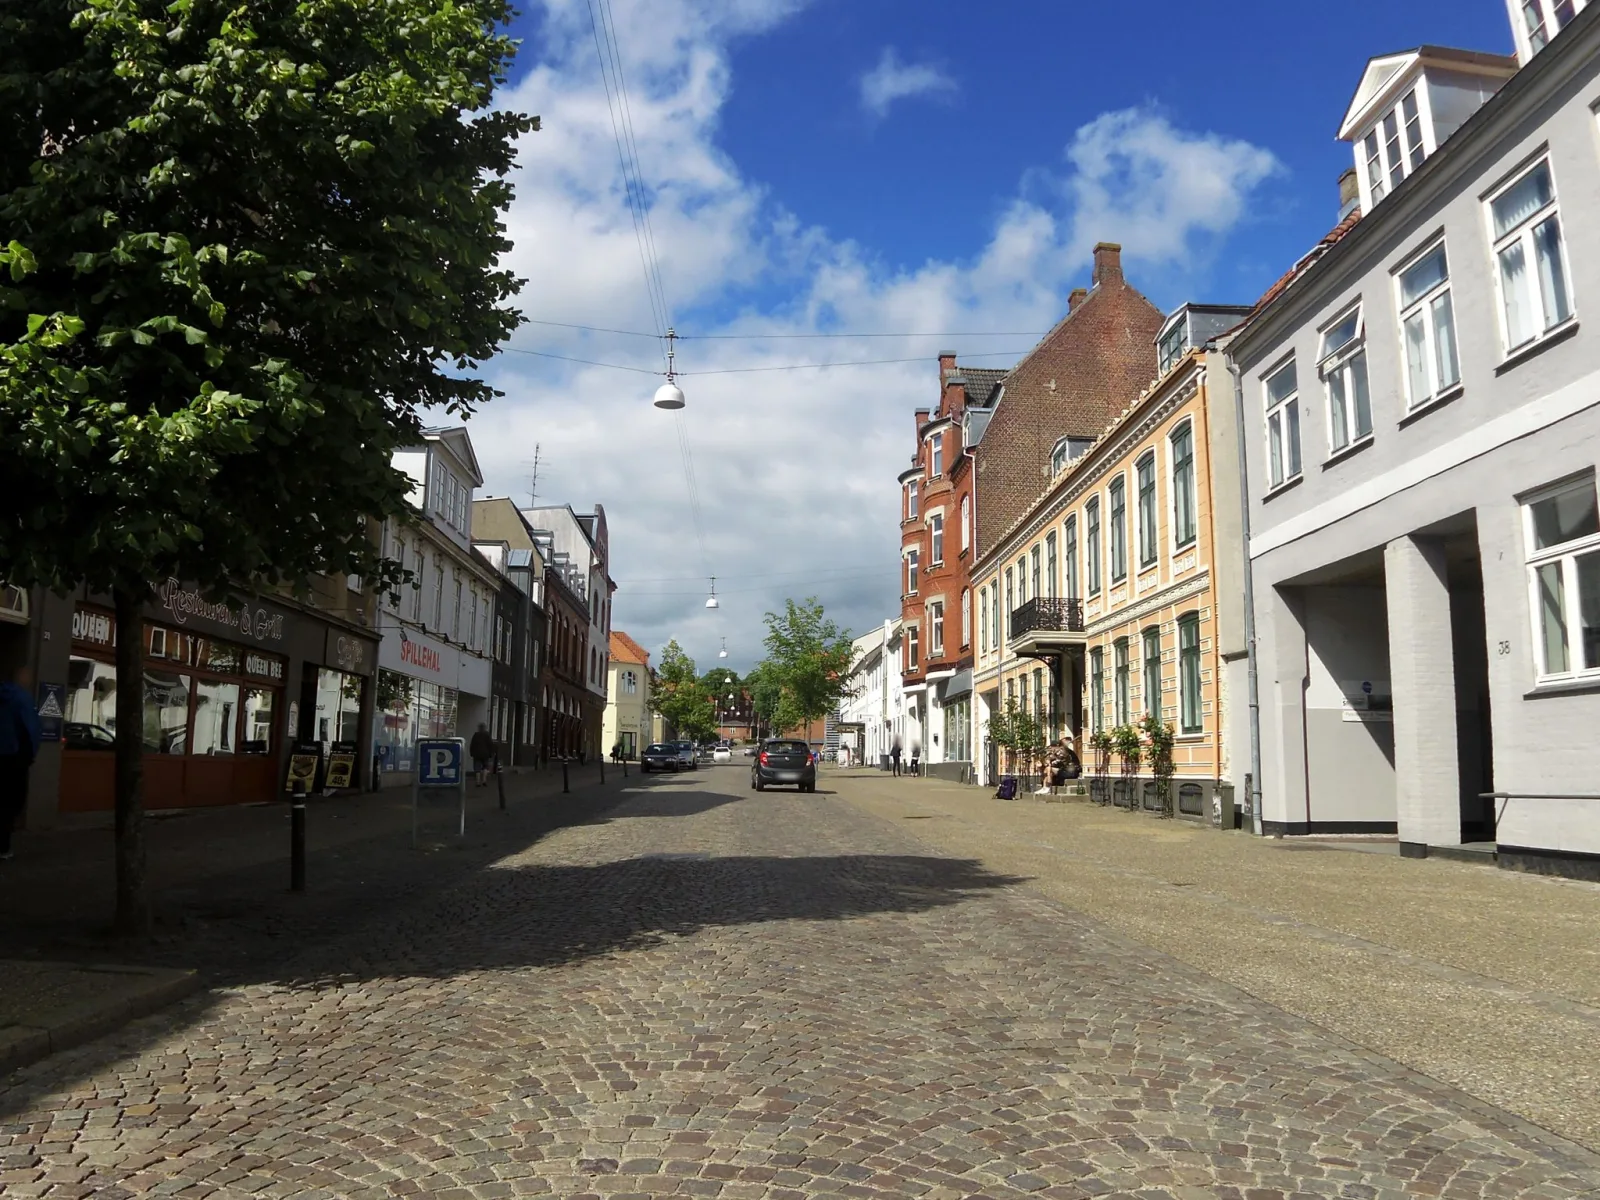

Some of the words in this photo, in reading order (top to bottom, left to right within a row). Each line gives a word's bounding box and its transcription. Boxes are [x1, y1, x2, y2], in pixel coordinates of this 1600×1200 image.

[72, 611, 110, 643] QUEEN
[240, 603, 252, 636] &
[254, 608, 284, 640] Grill
[400, 639, 441, 673] SPILLEHAL
[1498, 640, 1511, 656] 38
[246, 655, 269, 676] QUEEN
[270, 661, 282, 678] BEE
[426, 748, 454, 779] P
